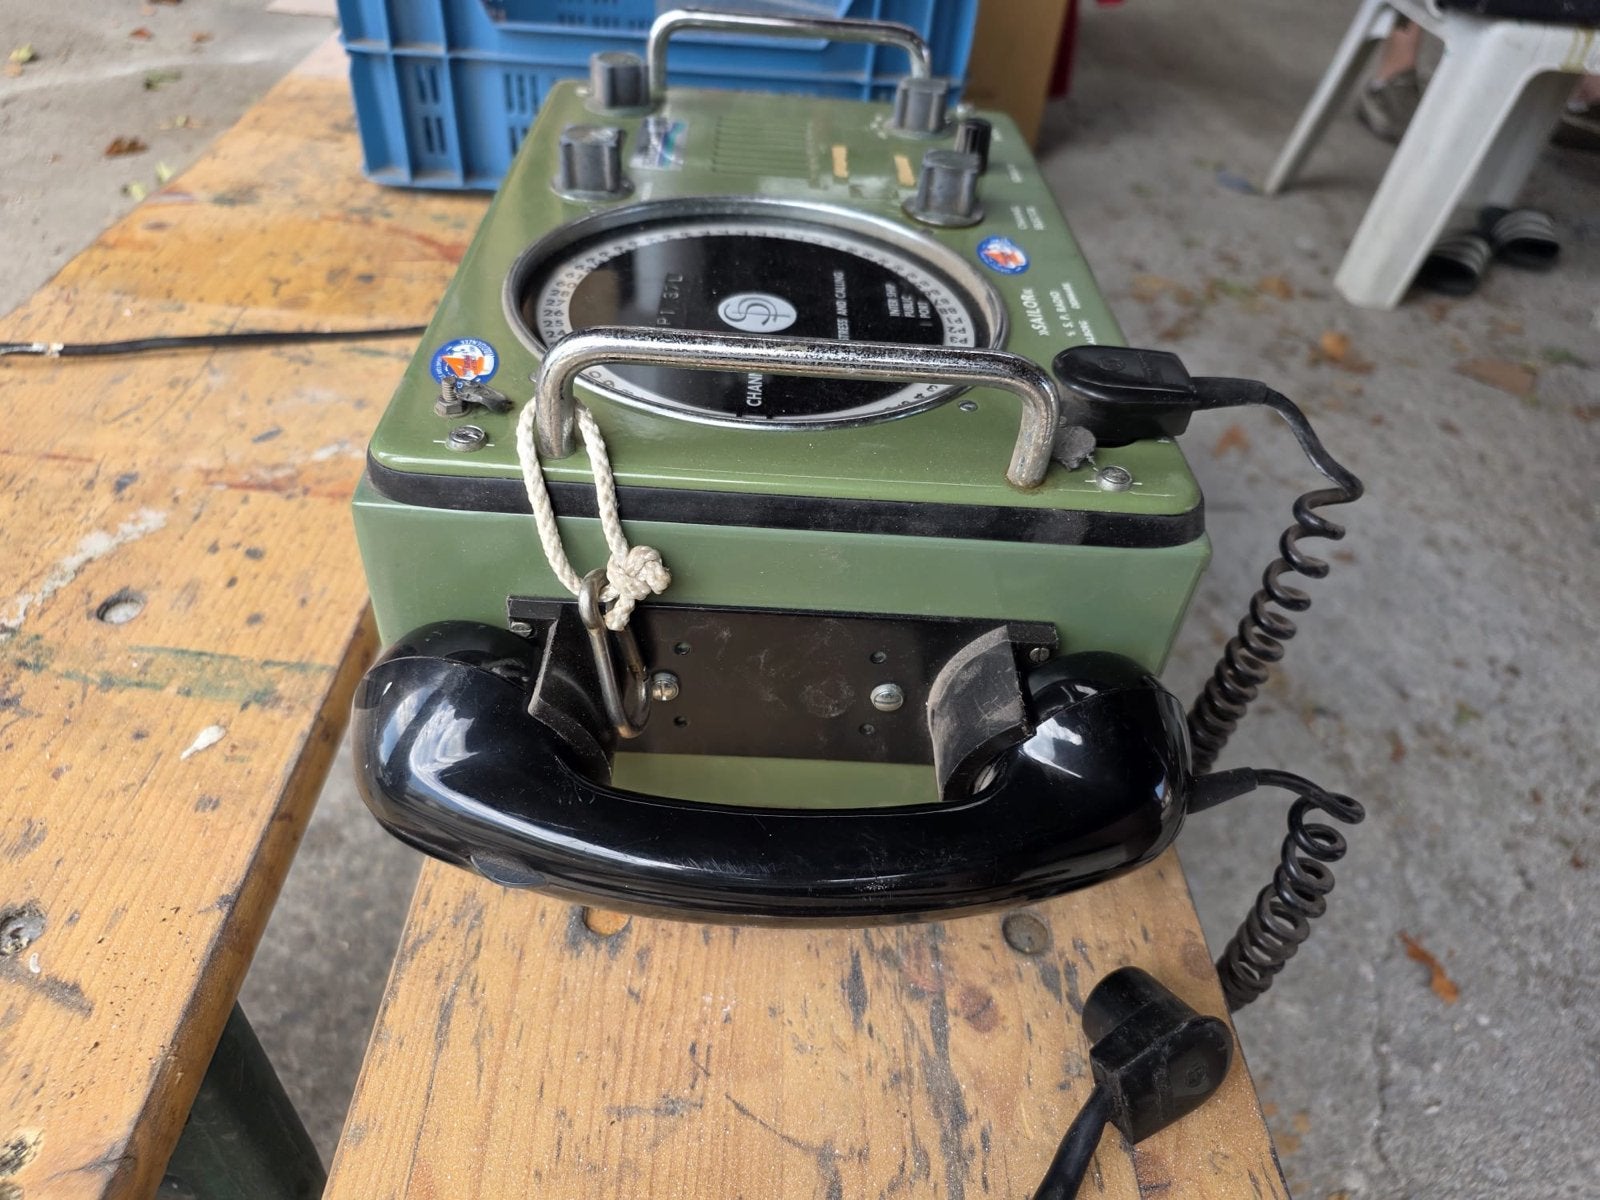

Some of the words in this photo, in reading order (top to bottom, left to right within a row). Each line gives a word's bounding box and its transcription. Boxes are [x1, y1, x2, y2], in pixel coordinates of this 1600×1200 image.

[833, 271, 846, 299] CALLING
[836, 301, 848, 316] AND
[887, 299, 900, 317] INTER
[901, 296, 915, 318] PUBLIC
[917, 301, 931, 319] PORT
[1049, 290, 1067, 313] RADIO
[543, 309, 565, 318] 26
[543, 319, 565, 329] 25
[948, 326, 967, 336] P2
[1078, 319, 1097, 345] ALBORG
[949, 336, 969, 345] P3
